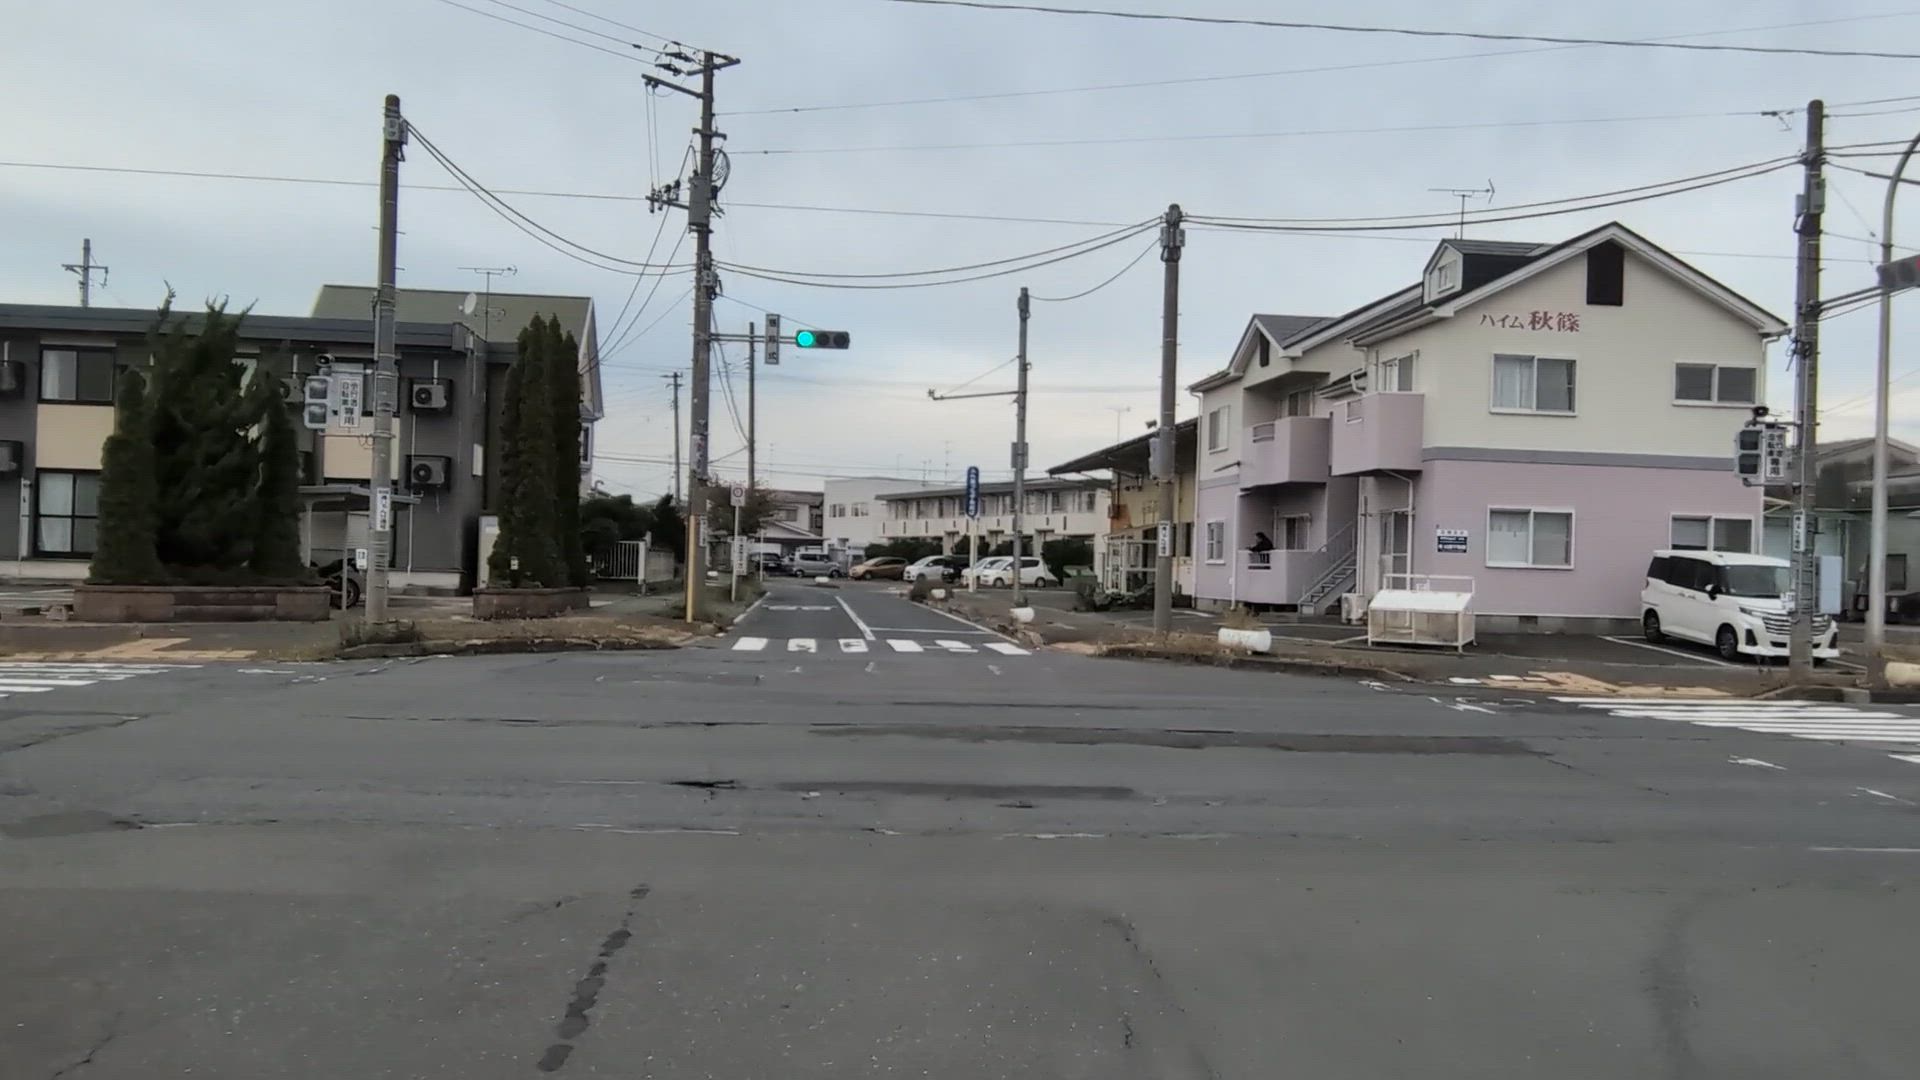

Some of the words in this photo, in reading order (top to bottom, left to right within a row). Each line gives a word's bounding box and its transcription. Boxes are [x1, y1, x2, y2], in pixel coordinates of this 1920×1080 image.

[1480, 310, 1580, 332] ハイム秋篠
